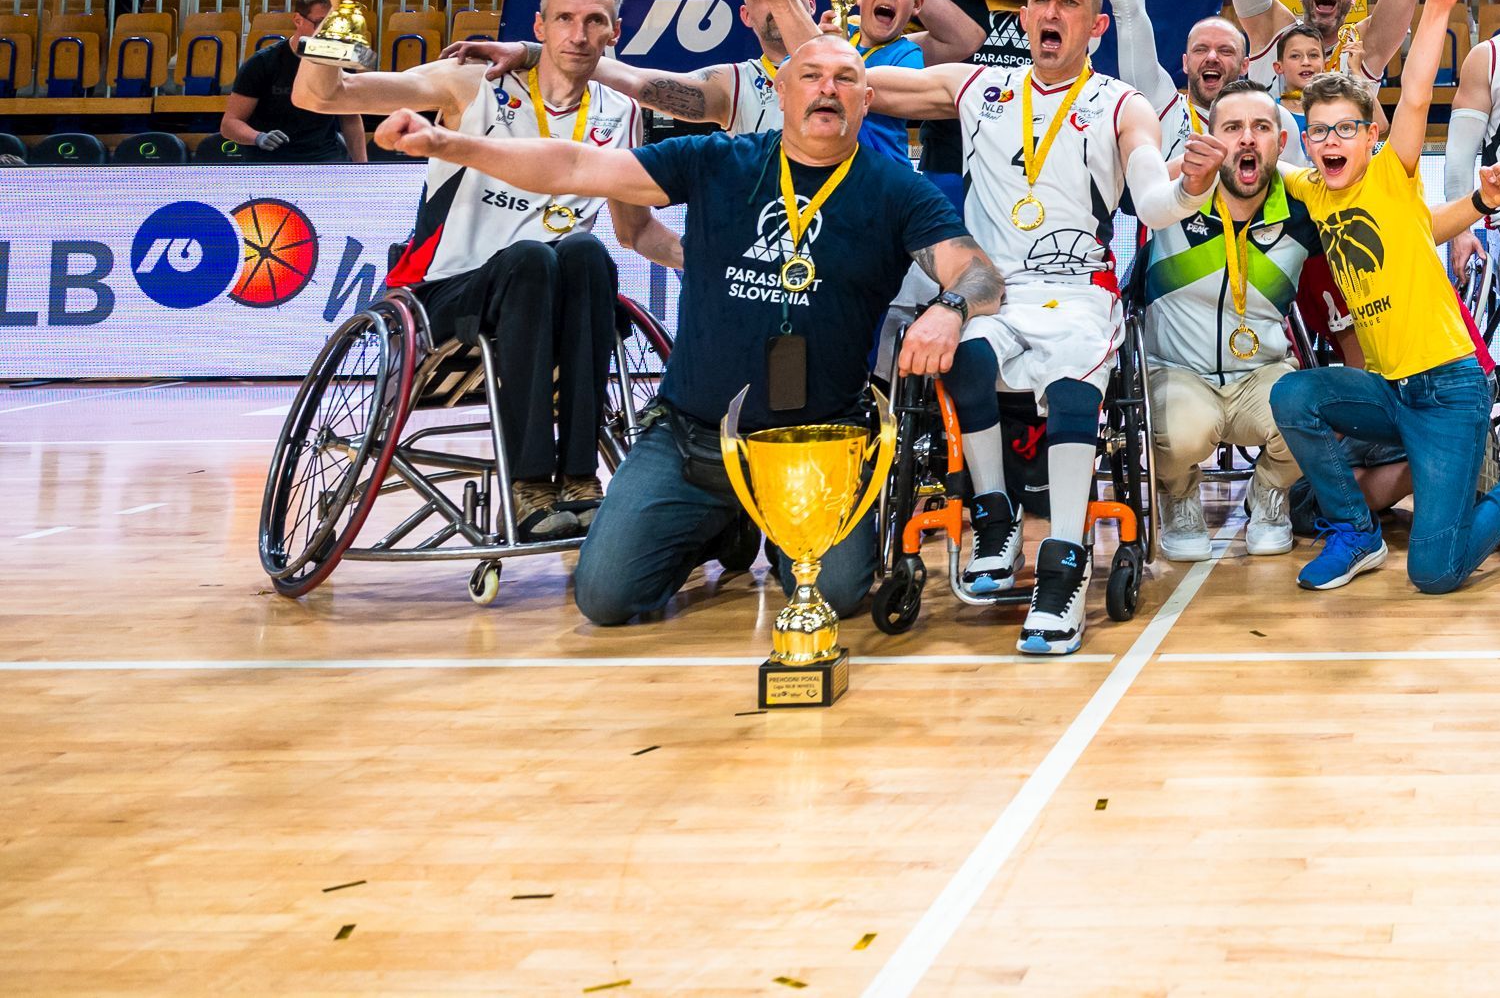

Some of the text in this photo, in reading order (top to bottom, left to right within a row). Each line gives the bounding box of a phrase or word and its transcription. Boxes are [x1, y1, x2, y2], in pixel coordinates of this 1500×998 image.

[973, 53, 1034, 65] PARASPOR
[981, 102, 1004, 114] NLB
[481, 189, 529, 212] ZŠIS
[1186, 223, 1209, 236] PEAK
[0, 240, 116, 326] LB
[728, 283, 810, 307] SLOVENIA
[1356, 295, 1392, 320] YORK
